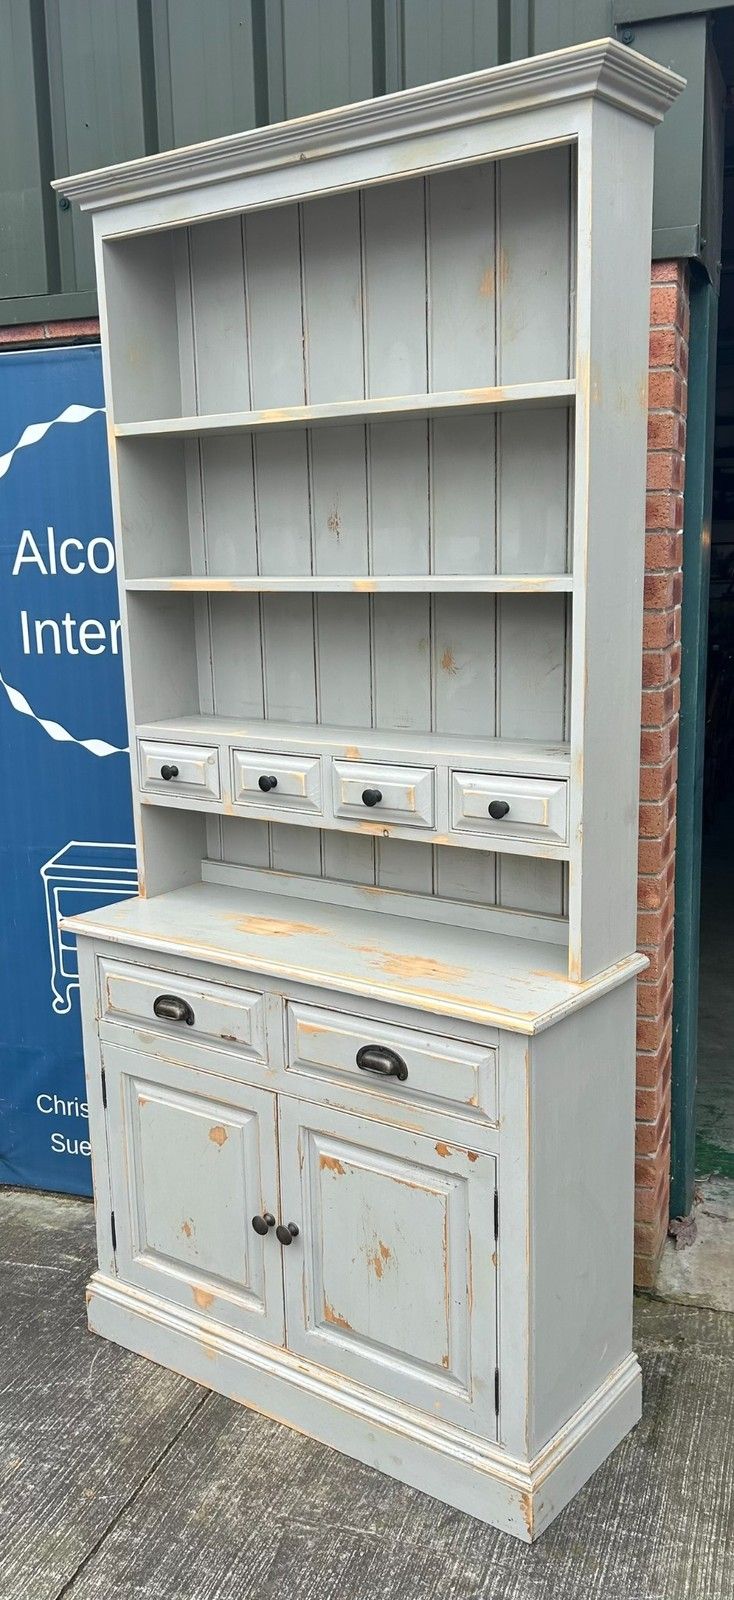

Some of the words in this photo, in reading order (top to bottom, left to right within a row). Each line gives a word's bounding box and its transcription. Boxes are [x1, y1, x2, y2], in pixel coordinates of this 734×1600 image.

[12, 526, 116, 575] Alco
[20, 610, 122, 655] Inter
[36, 1093, 90, 1119] Chris
[50, 1132, 92, 1156] Sue
